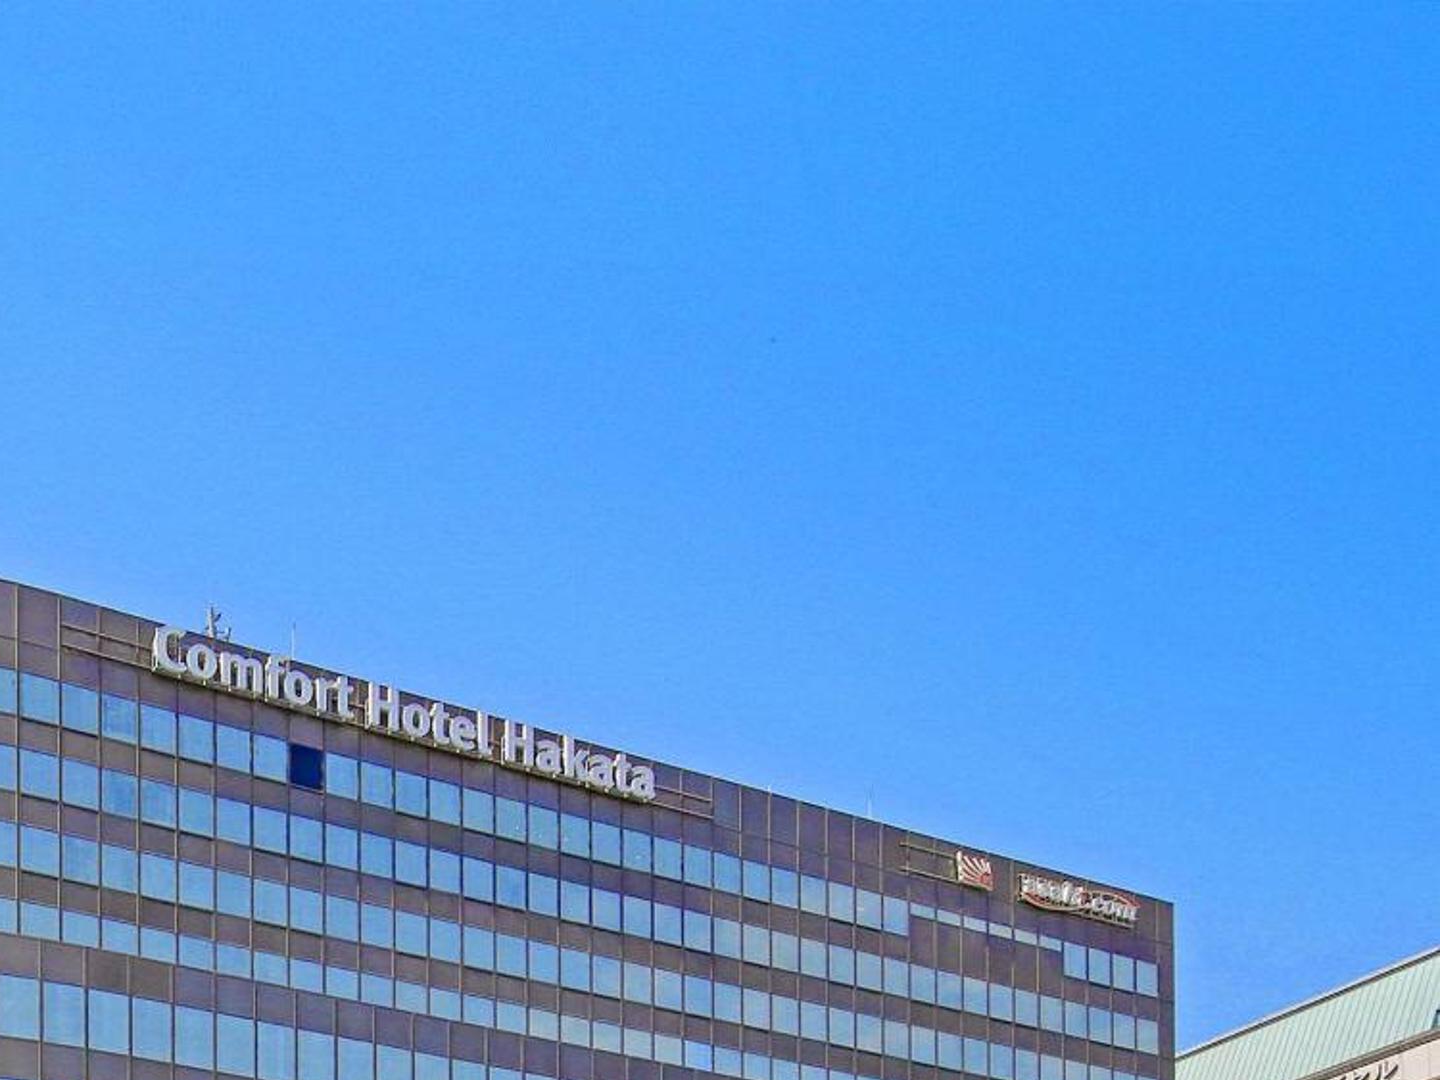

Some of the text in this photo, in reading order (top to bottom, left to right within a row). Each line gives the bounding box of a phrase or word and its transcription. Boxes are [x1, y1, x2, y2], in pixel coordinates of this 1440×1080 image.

[152, 627, 656, 801] Comfort Hotel Hakata
